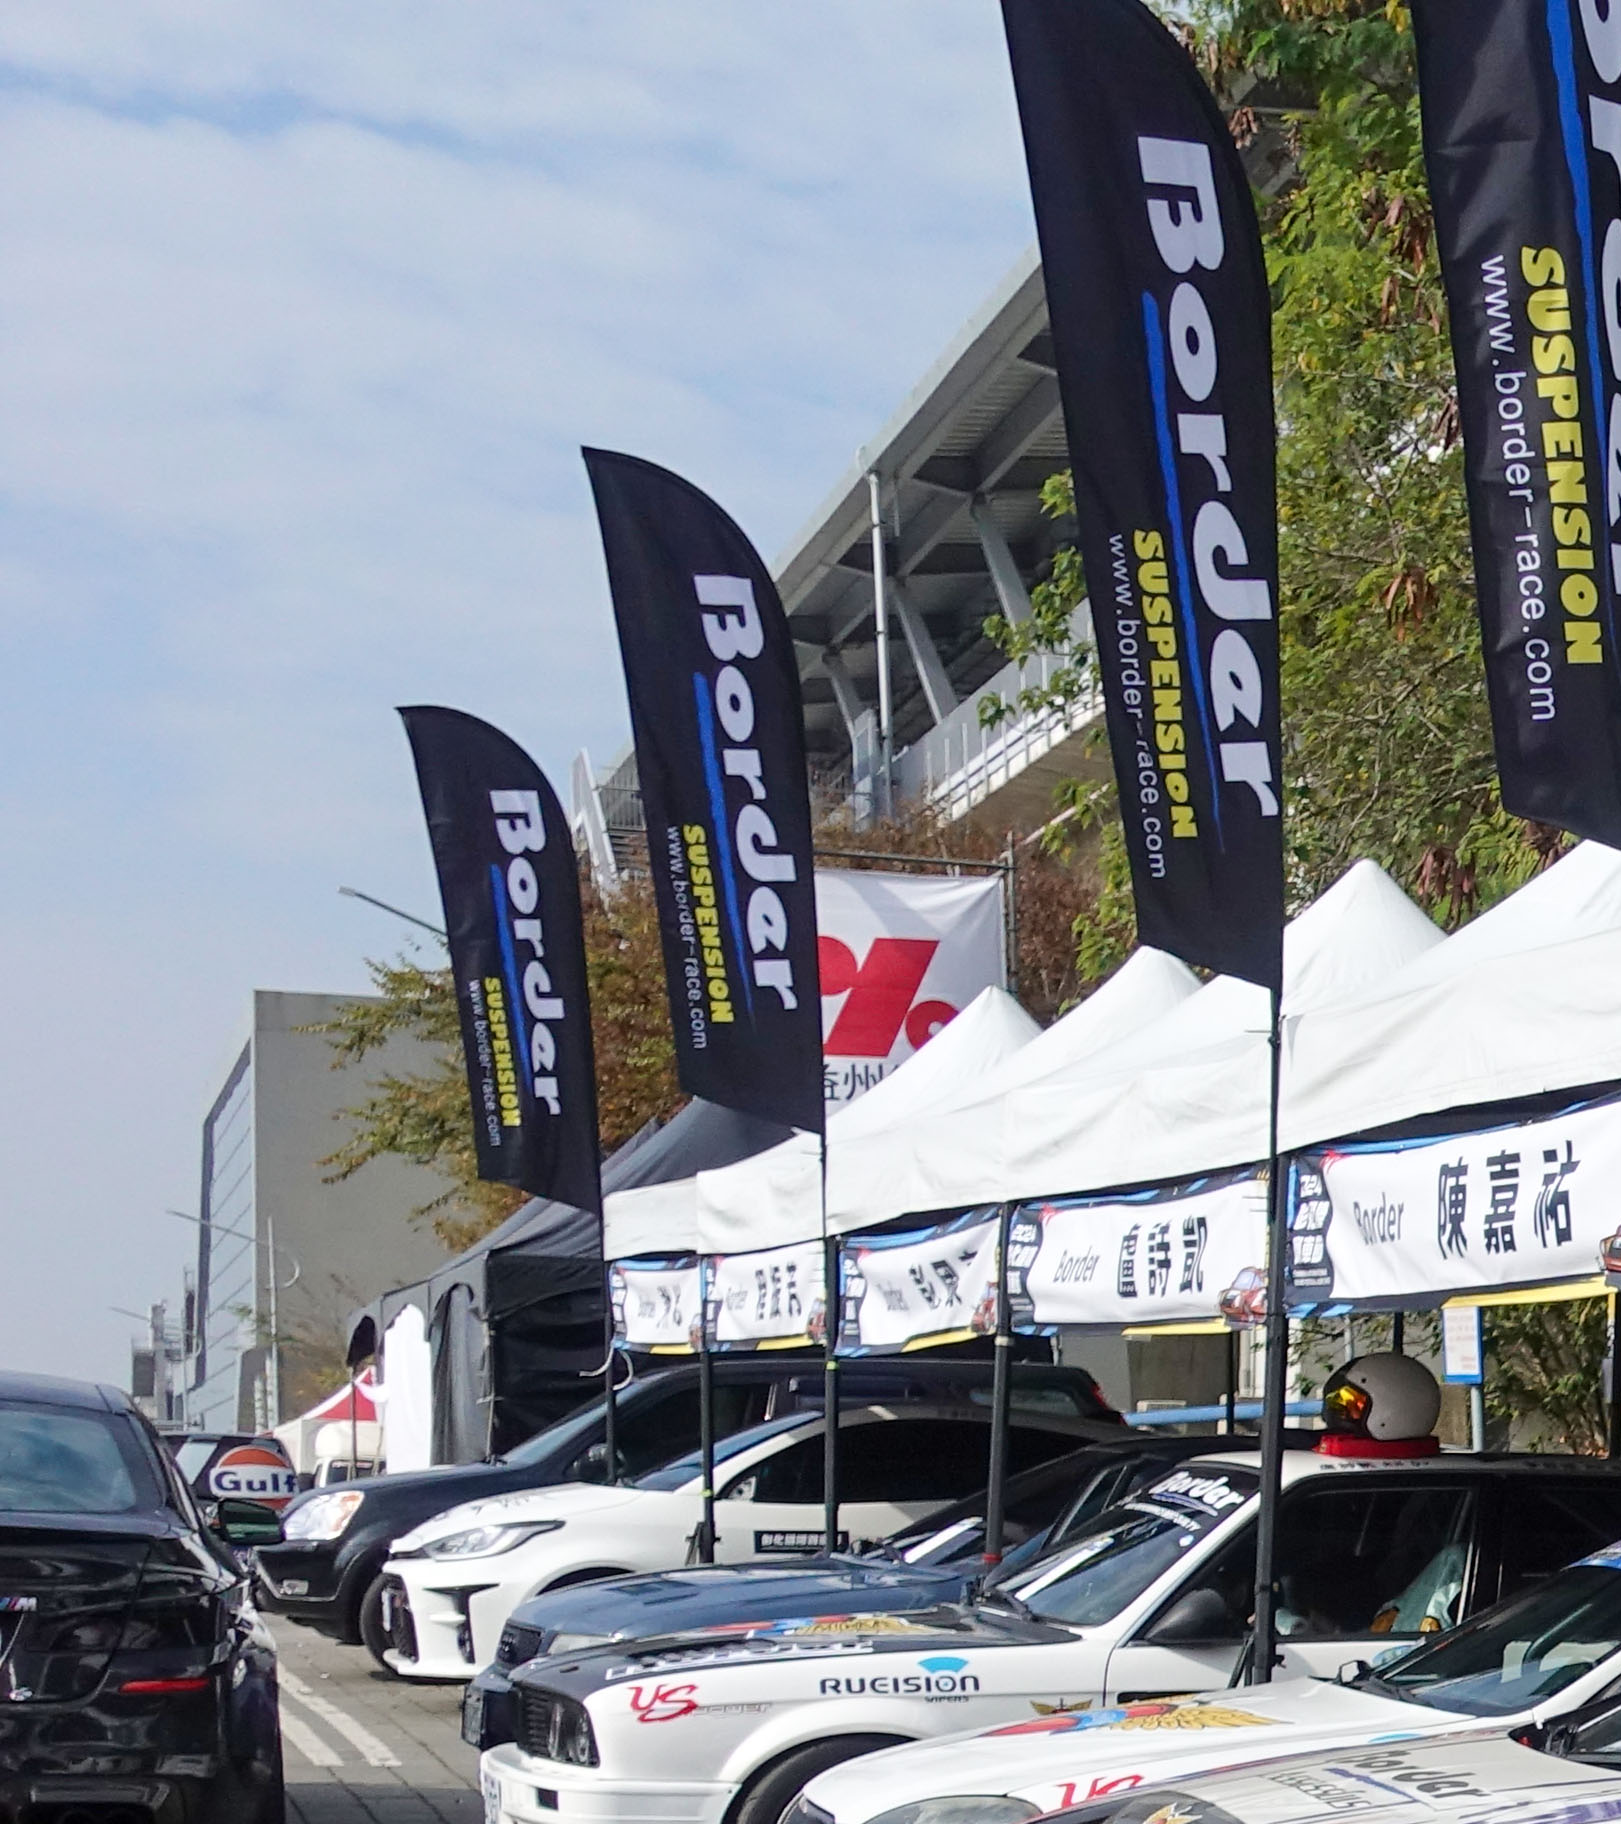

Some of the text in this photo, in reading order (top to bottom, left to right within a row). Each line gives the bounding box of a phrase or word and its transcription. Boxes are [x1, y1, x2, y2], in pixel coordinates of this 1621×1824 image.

[1479, 255, 1556, 723] www.border-race.com
[1521, 246, 1604, 665] SUSPENSION
[1108, 532, 1166, 880] www.border-race.com
[1133, 529, 1198, 840] SUSPENSION
[666, 826, 708, 1050] www.border-race.com
[682, 824, 734, 1025] SUSPENSION
[469, 978, 500, 1149] www.border-race.com
[483, 975, 522, 1128] SUSPENSION
[1053, 1245, 1100, 1283] Border
[1353, 1192, 1404, 1247] Border
[1438, 1140, 1581, 1260] 陳嘉祐
[213, 1470, 297, 1495] Gulf
